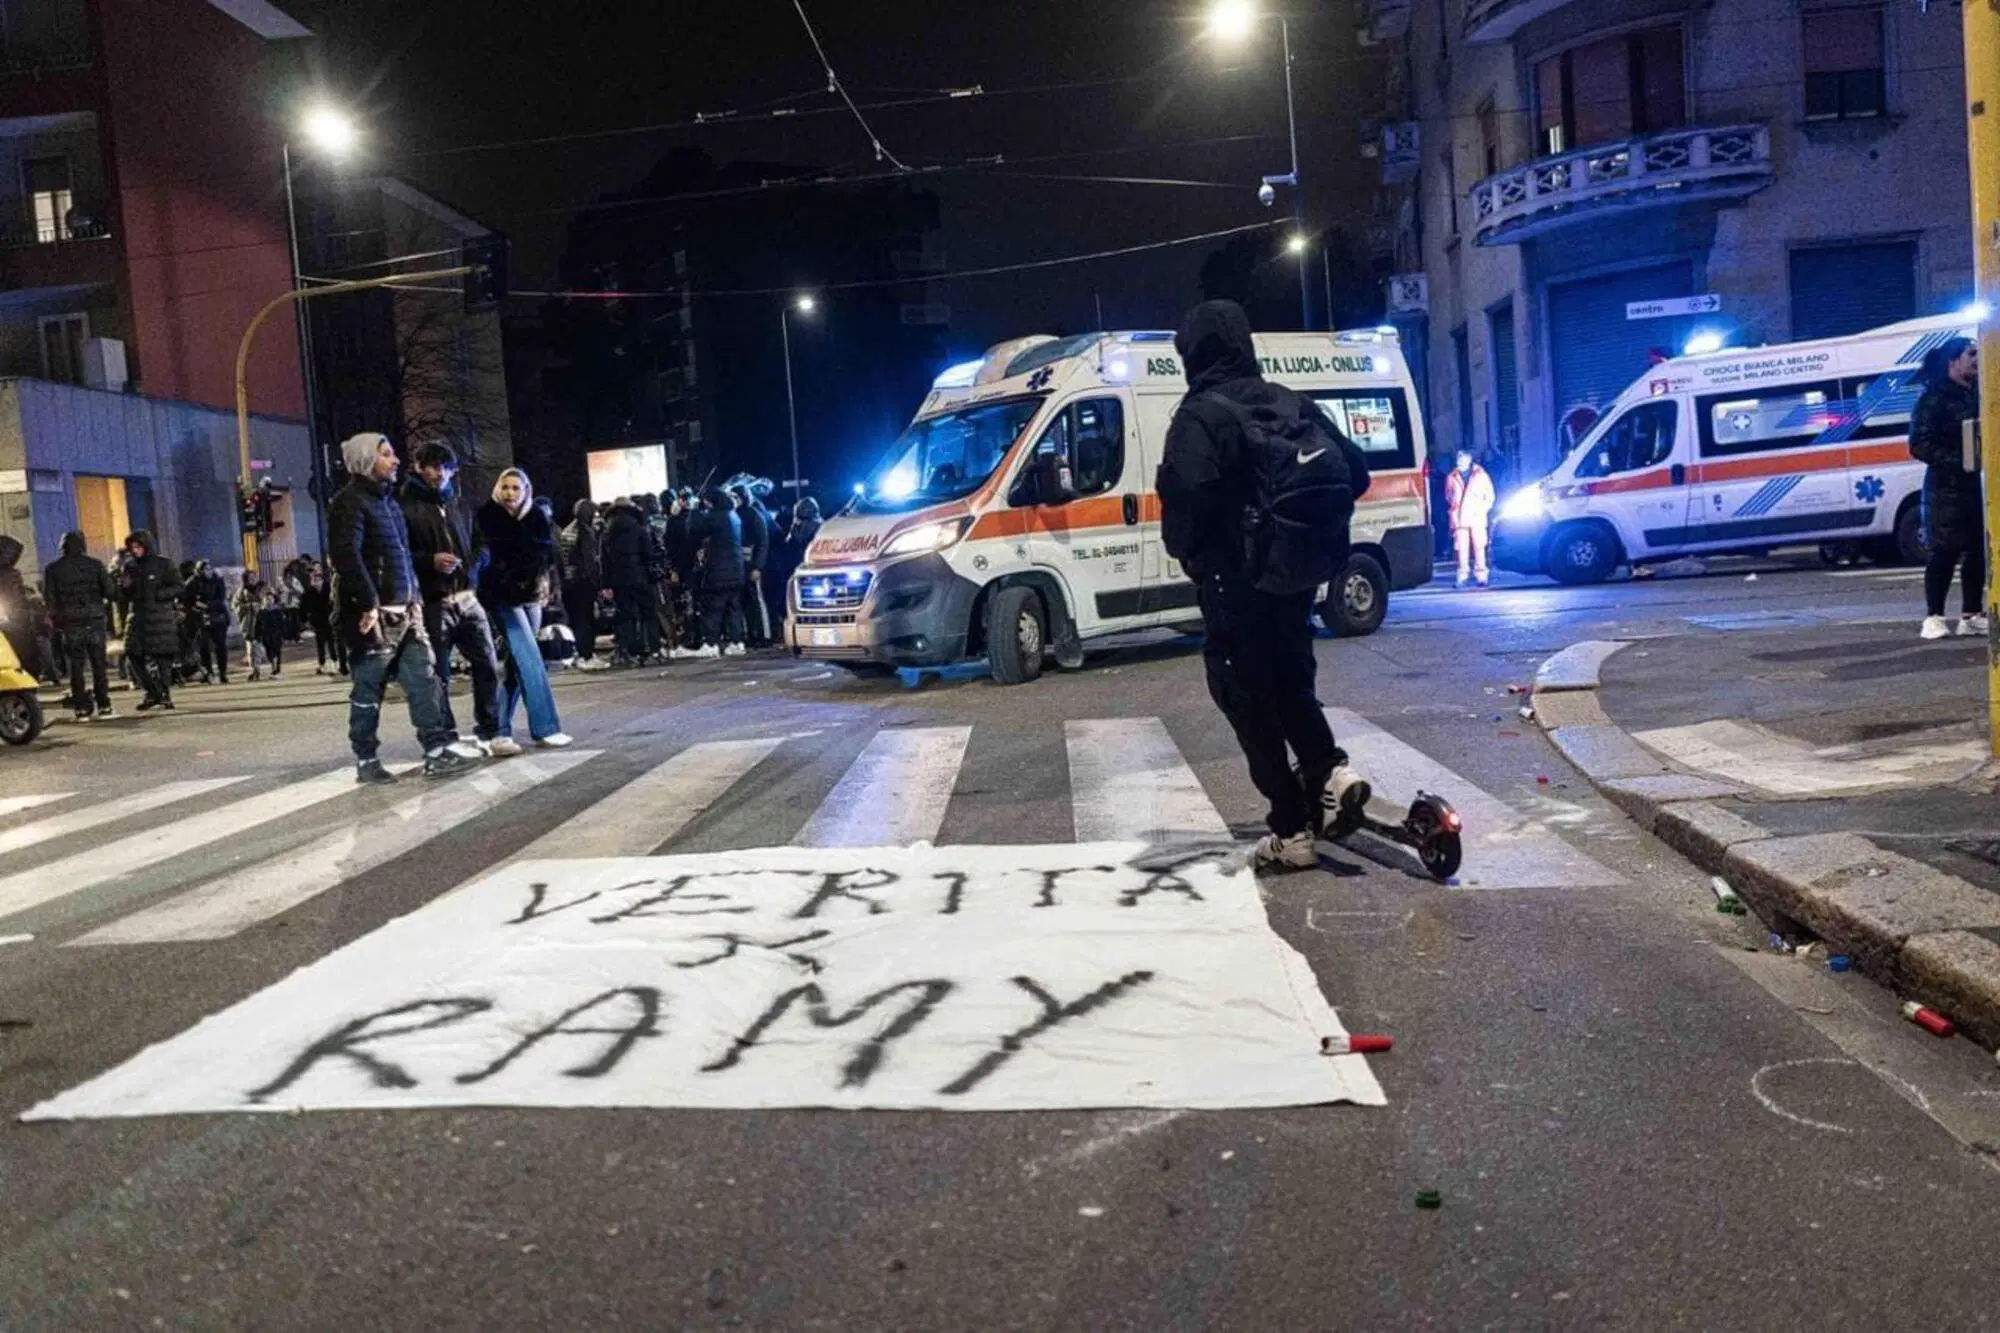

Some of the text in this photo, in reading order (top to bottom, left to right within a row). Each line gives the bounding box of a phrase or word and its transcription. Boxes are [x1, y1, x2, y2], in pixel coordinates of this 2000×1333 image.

[1147, 357, 1181, 376] ASS.
[1283, 356, 1324, 373] LUCIA
[1331, 355, 1373, 372] ONLUS
[1744, 360, 1785, 371] BIANCA
[1787, 353, 1830, 366] MILANO
[1744, 369, 1782, 380] MILANO
[1783, 363, 1824, 375] CENTRO
[244, 968, 1156, 1103] RAMY
